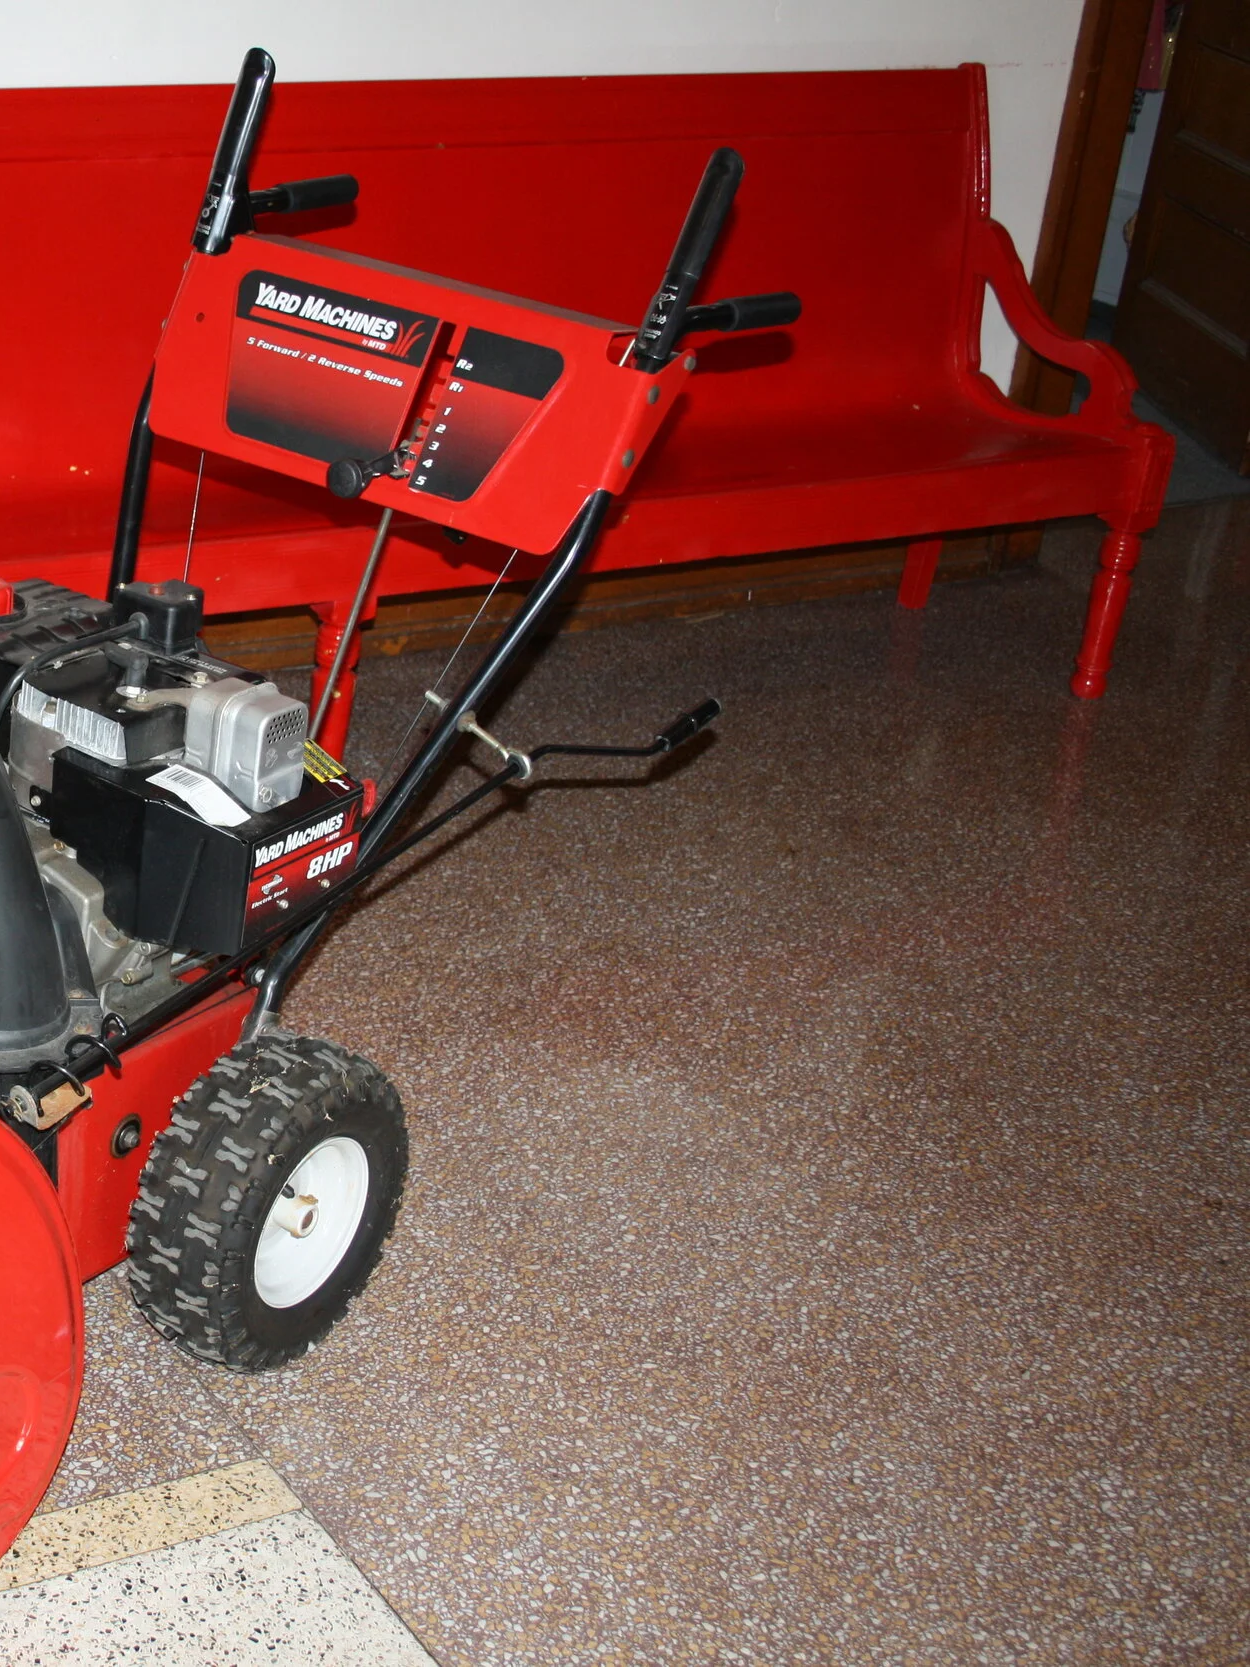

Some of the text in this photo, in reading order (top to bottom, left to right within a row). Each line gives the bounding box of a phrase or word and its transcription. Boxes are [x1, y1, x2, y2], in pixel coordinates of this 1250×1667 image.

[254, 282, 398, 341] YARD MACHINES
[367, 339, 387, 351] MTD
[246, 336, 256, 345] 5
[257, 340, 301, 358] Forward
[307, 354, 317, 363] 2
[318, 357, 362, 376] Reverse
[363, 369, 404, 388] Speeds
[456, 358, 474, 371] R2
[449, 381, 464, 393] R1
[443, 407, 452, 416] 1
[435, 423, 447, 434] 2
[429, 441, 440, 451] 3
[422, 458, 434, 468] 4
[415, 475, 427, 486] 5
[254, 812, 344, 868] YARD MACHINES
[306, 841, 353, 879] 8HP
[273, 887, 289, 899] Start
